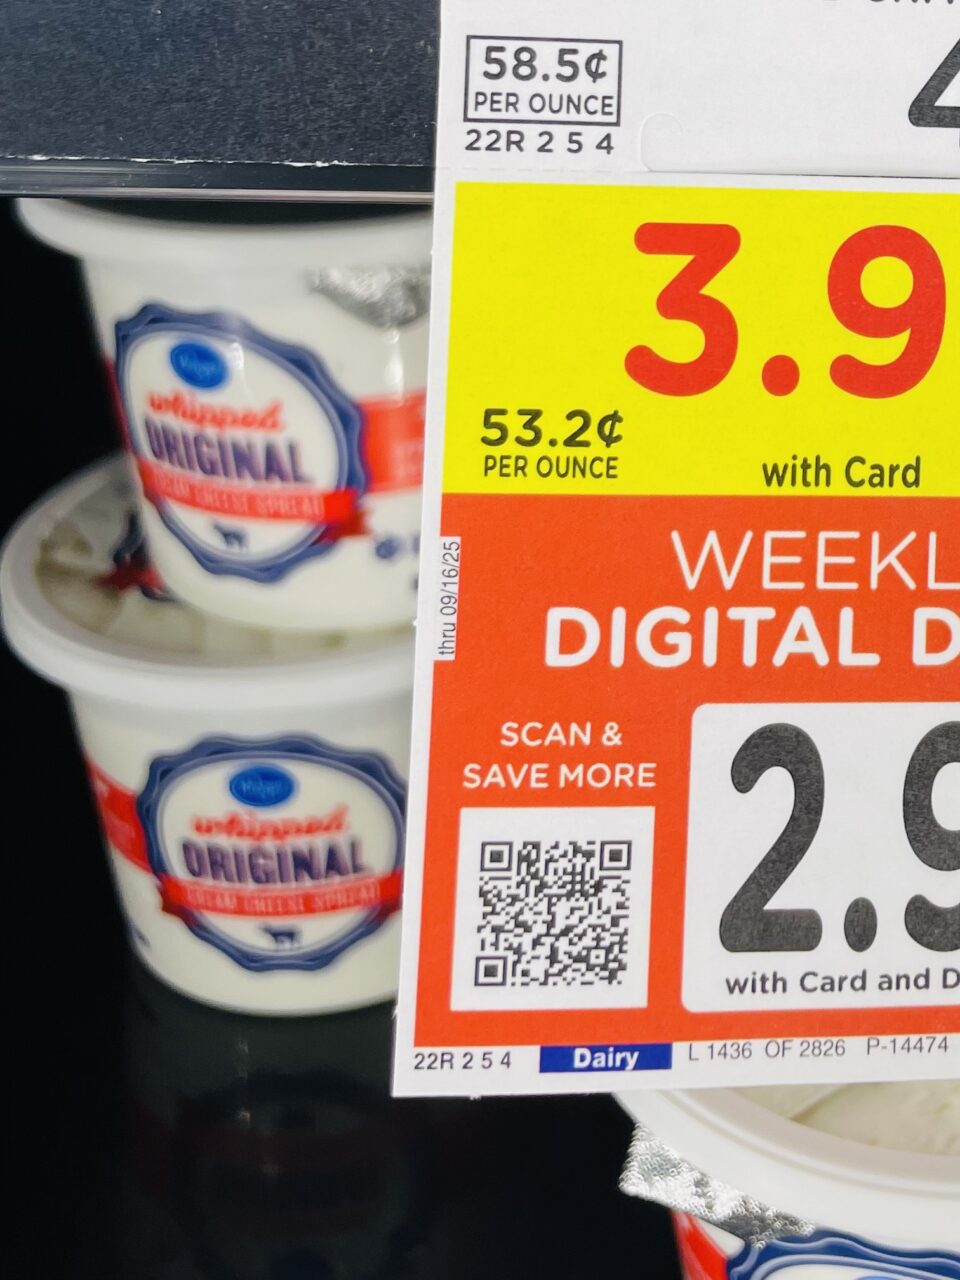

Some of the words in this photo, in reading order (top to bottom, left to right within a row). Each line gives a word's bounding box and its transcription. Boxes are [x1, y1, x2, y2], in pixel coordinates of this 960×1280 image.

[480, 44, 609, 84] 58.5¢
[474, 91, 519, 113] PER
[528, 92, 614, 116] OUNCE
[464, 128, 525, 153] 22R
[537, 130, 554, 153] 2
[566, 131, 583, 154] 5
[595, 132, 614, 155] 4
[480, 408, 624, 449] 53.2¢
[145, 416, 312, 484] ORIGINAL
[484, 454, 528, 478] PER
[536, 455, 618, 479] OUNCE
[762, 454, 831, 488] with
[844, 455, 921, 489] Card
[440, 541, 461, 616] 09/16/25
[437, 622, 456, 656] thru
[544, 605, 881, 668] DIGITAL
[501, 721, 591, 747] SCAN
[601, 722, 622, 746] &
[463, 763, 549, 789] SAVE
[559, 762, 656, 788] MORE
[182, 840, 366, 885] ORIGINAL
[725, 971, 787, 995] with
[799, 969, 867, 993] Card
[878, 967, 930, 991] and
[414, 1052, 454, 1070] 22R
[462, 1052, 474, 1070] 2
[481, 1052, 493, 1069] 5
[500, 1051, 511, 1069] 4
[572, 1045, 640, 1071] Dairy
[688, 1043, 699, 1062] L
[709, 1042, 752, 1059] 1436
[764, 1039, 794, 1059] OF
[799, 1040, 846, 1057] 2826
[867, 1036, 948, 1055] P-14474
